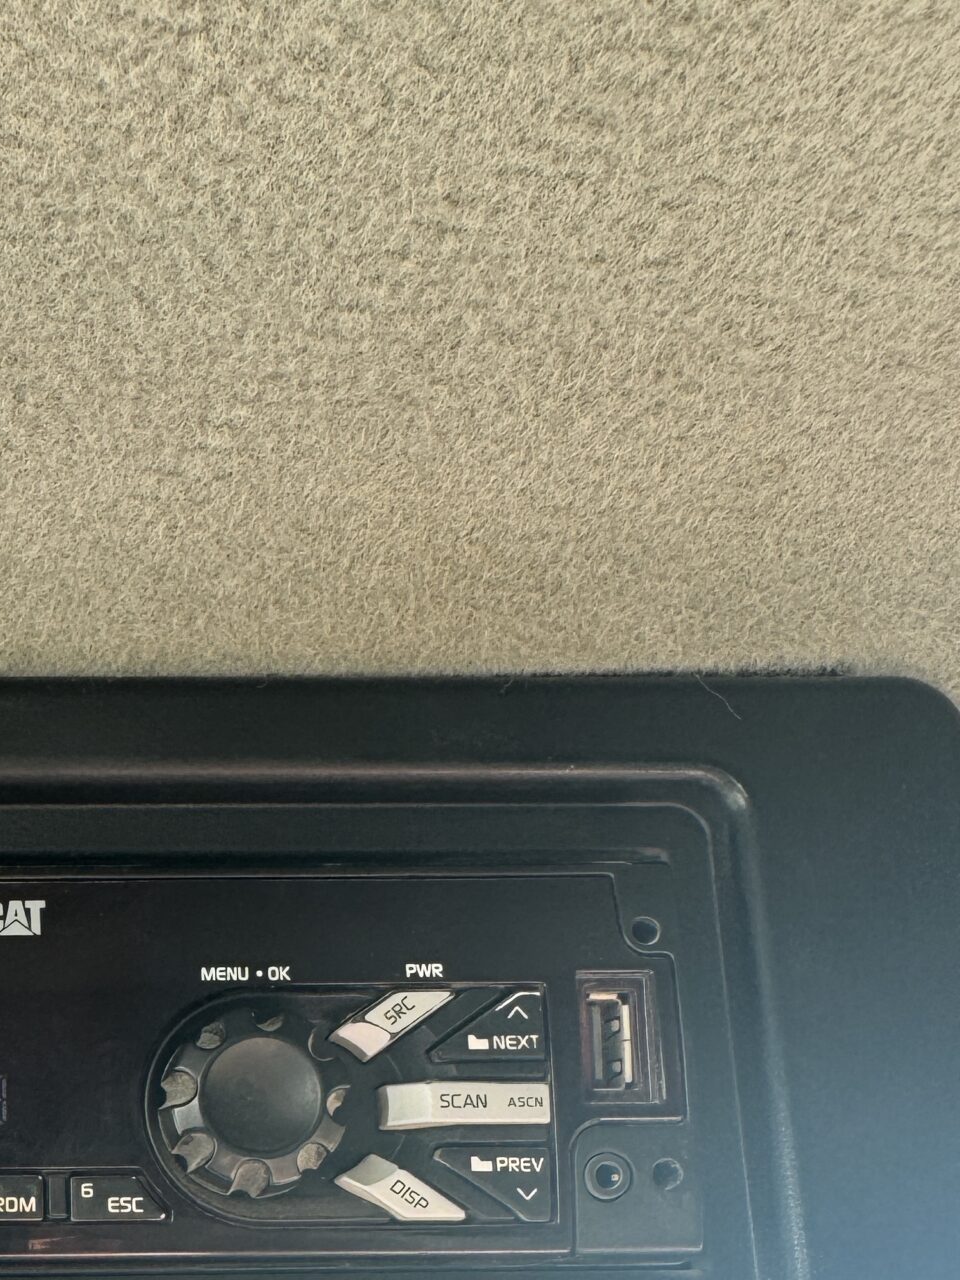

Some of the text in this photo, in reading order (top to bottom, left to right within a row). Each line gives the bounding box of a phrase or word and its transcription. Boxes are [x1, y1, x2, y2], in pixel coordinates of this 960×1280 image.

[200, 966, 291, 981] MENU OK
[405, 963, 443, 978] PWR
[383, 996, 417, 1026] SRC
[493, 1034, 539, 1050] NEXT
[440, 1093, 544, 1110] SCAN ASCN
[496, 1157, 544, 1173] PREV
[81, 1183, 93, 1198] 6
[389, 1179, 429, 1210] DISP
[107, 1196, 144, 1213] ESC
